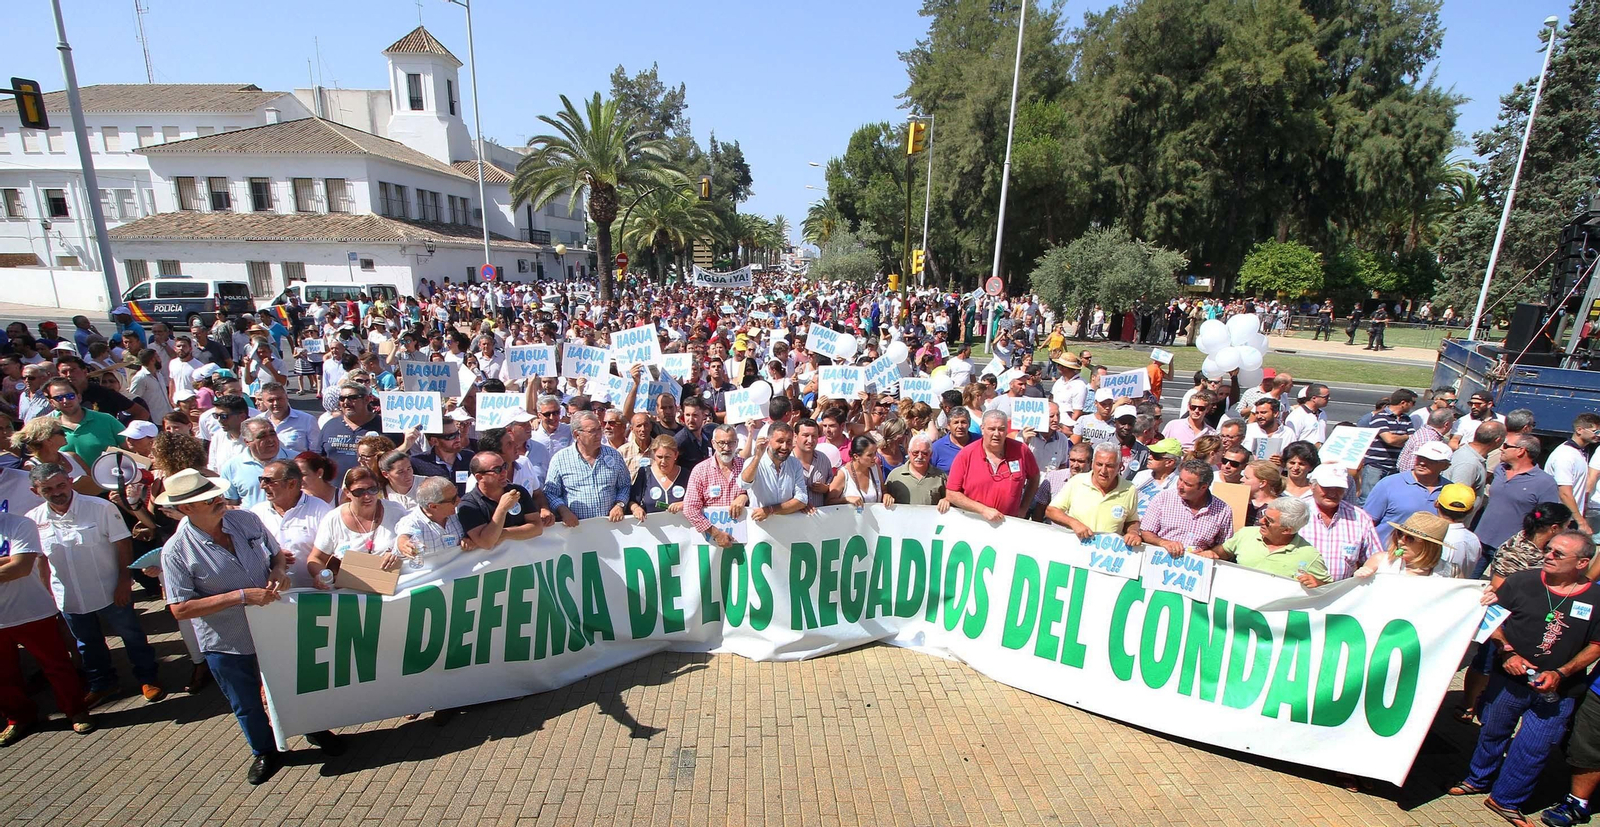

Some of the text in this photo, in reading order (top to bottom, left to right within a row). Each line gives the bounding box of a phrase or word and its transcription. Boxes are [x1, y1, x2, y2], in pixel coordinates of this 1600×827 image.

[697, 273, 726, 284] AGUA
[510, 349, 549, 363] ¡¡AGUA
[566, 346, 605, 364] ¡¡AGUA
[627, 345, 651, 364] YA!!
[406, 363, 451, 378] ¡¡AGUA
[521, 363, 545, 377] YA!!
[575, 362, 600, 377] YA!!
[822, 369, 859, 381] ¡¡AGUA
[417, 379, 448, 393] YA!!
[1104, 374, 1138, 387] ¡¡AGUA
[831, 382, 855, 395] YA!!
[386, 395, 434, 411] ¡¡AGUA
[1014, 400, 1044, 414] ¡¡AGUA
[1088, 551, 1125, 573] YA!!
[1161, 569, 1198, 592] YA!!
[296, 592, 383, 695] EN
[401, 550, 615, 677] DEFENSA
[627, 542, 687, 640] DE
[698, 542, 774, 631] LOS
[789, 524, 997, 640] REGADÍOS
[1001, 553, 1089, 669] DEL
[1108, 575, 1421, 737] CONDADO
